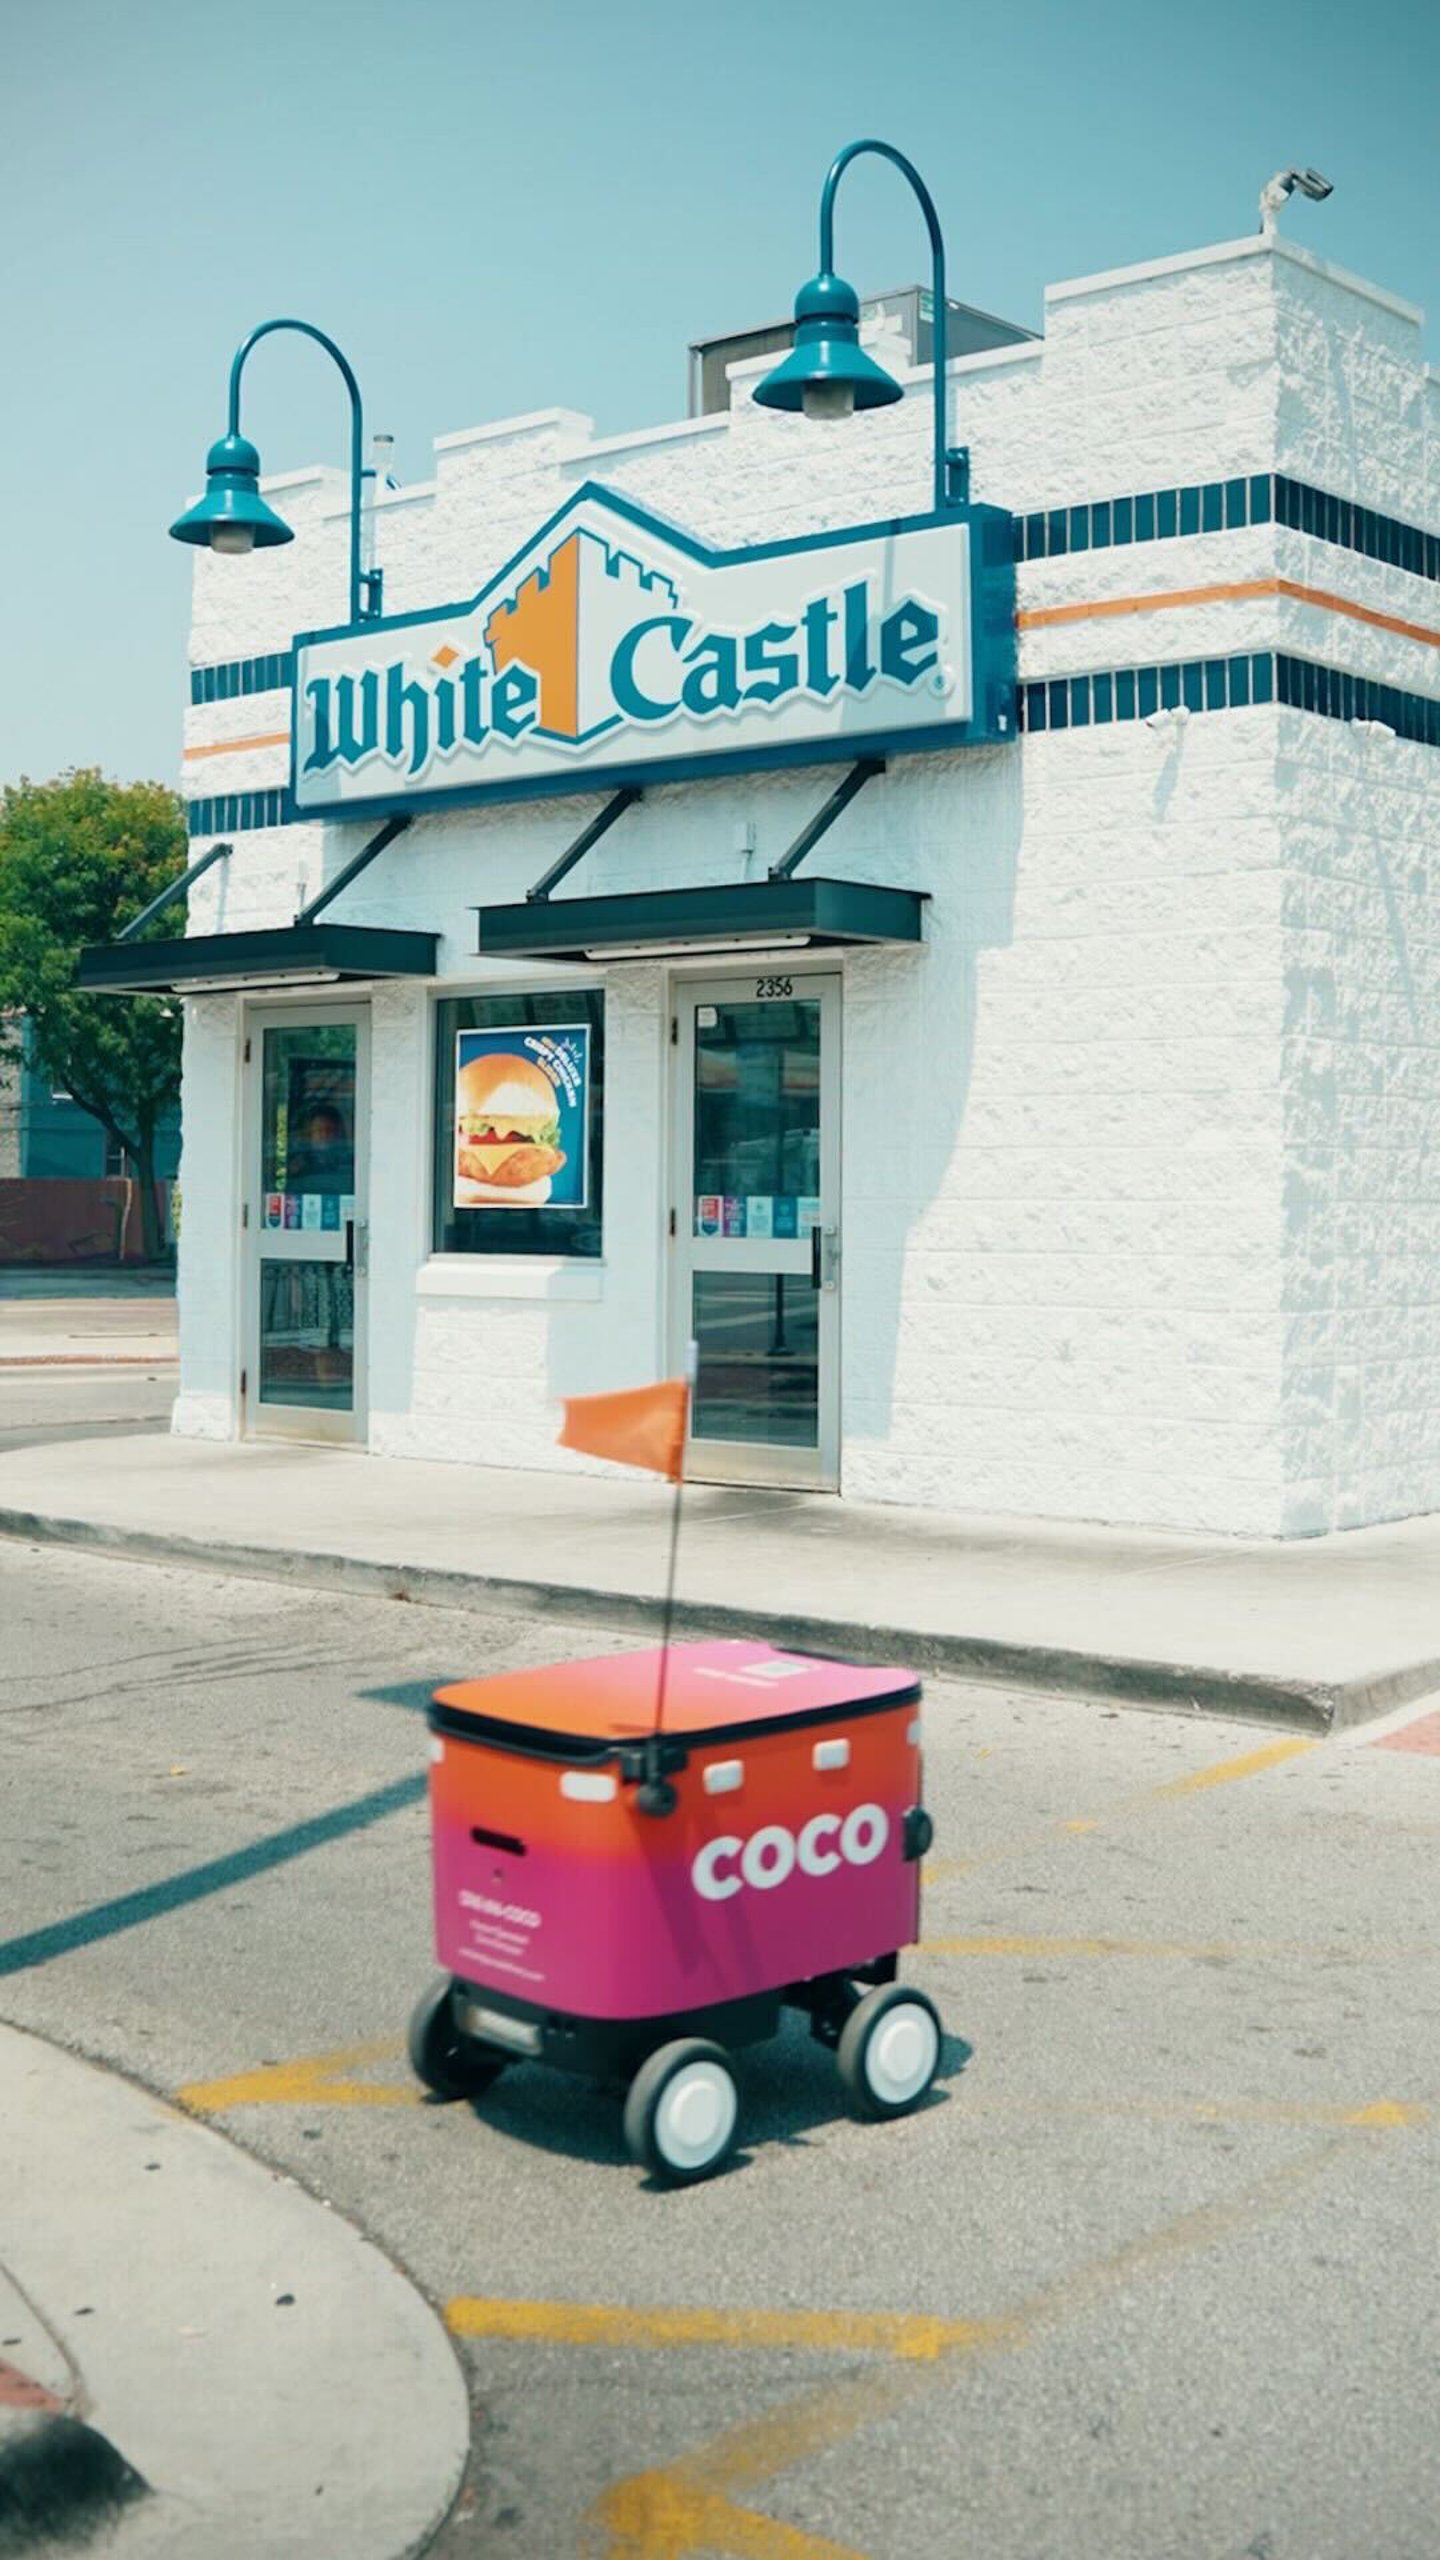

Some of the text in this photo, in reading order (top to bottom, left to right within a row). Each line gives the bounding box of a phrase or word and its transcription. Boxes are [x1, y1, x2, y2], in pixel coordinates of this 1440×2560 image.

[303, 580, 940, 774] White Castle
[756, 977, 792, 997] 2356
[692, 1803, 889, 1900] COCO
